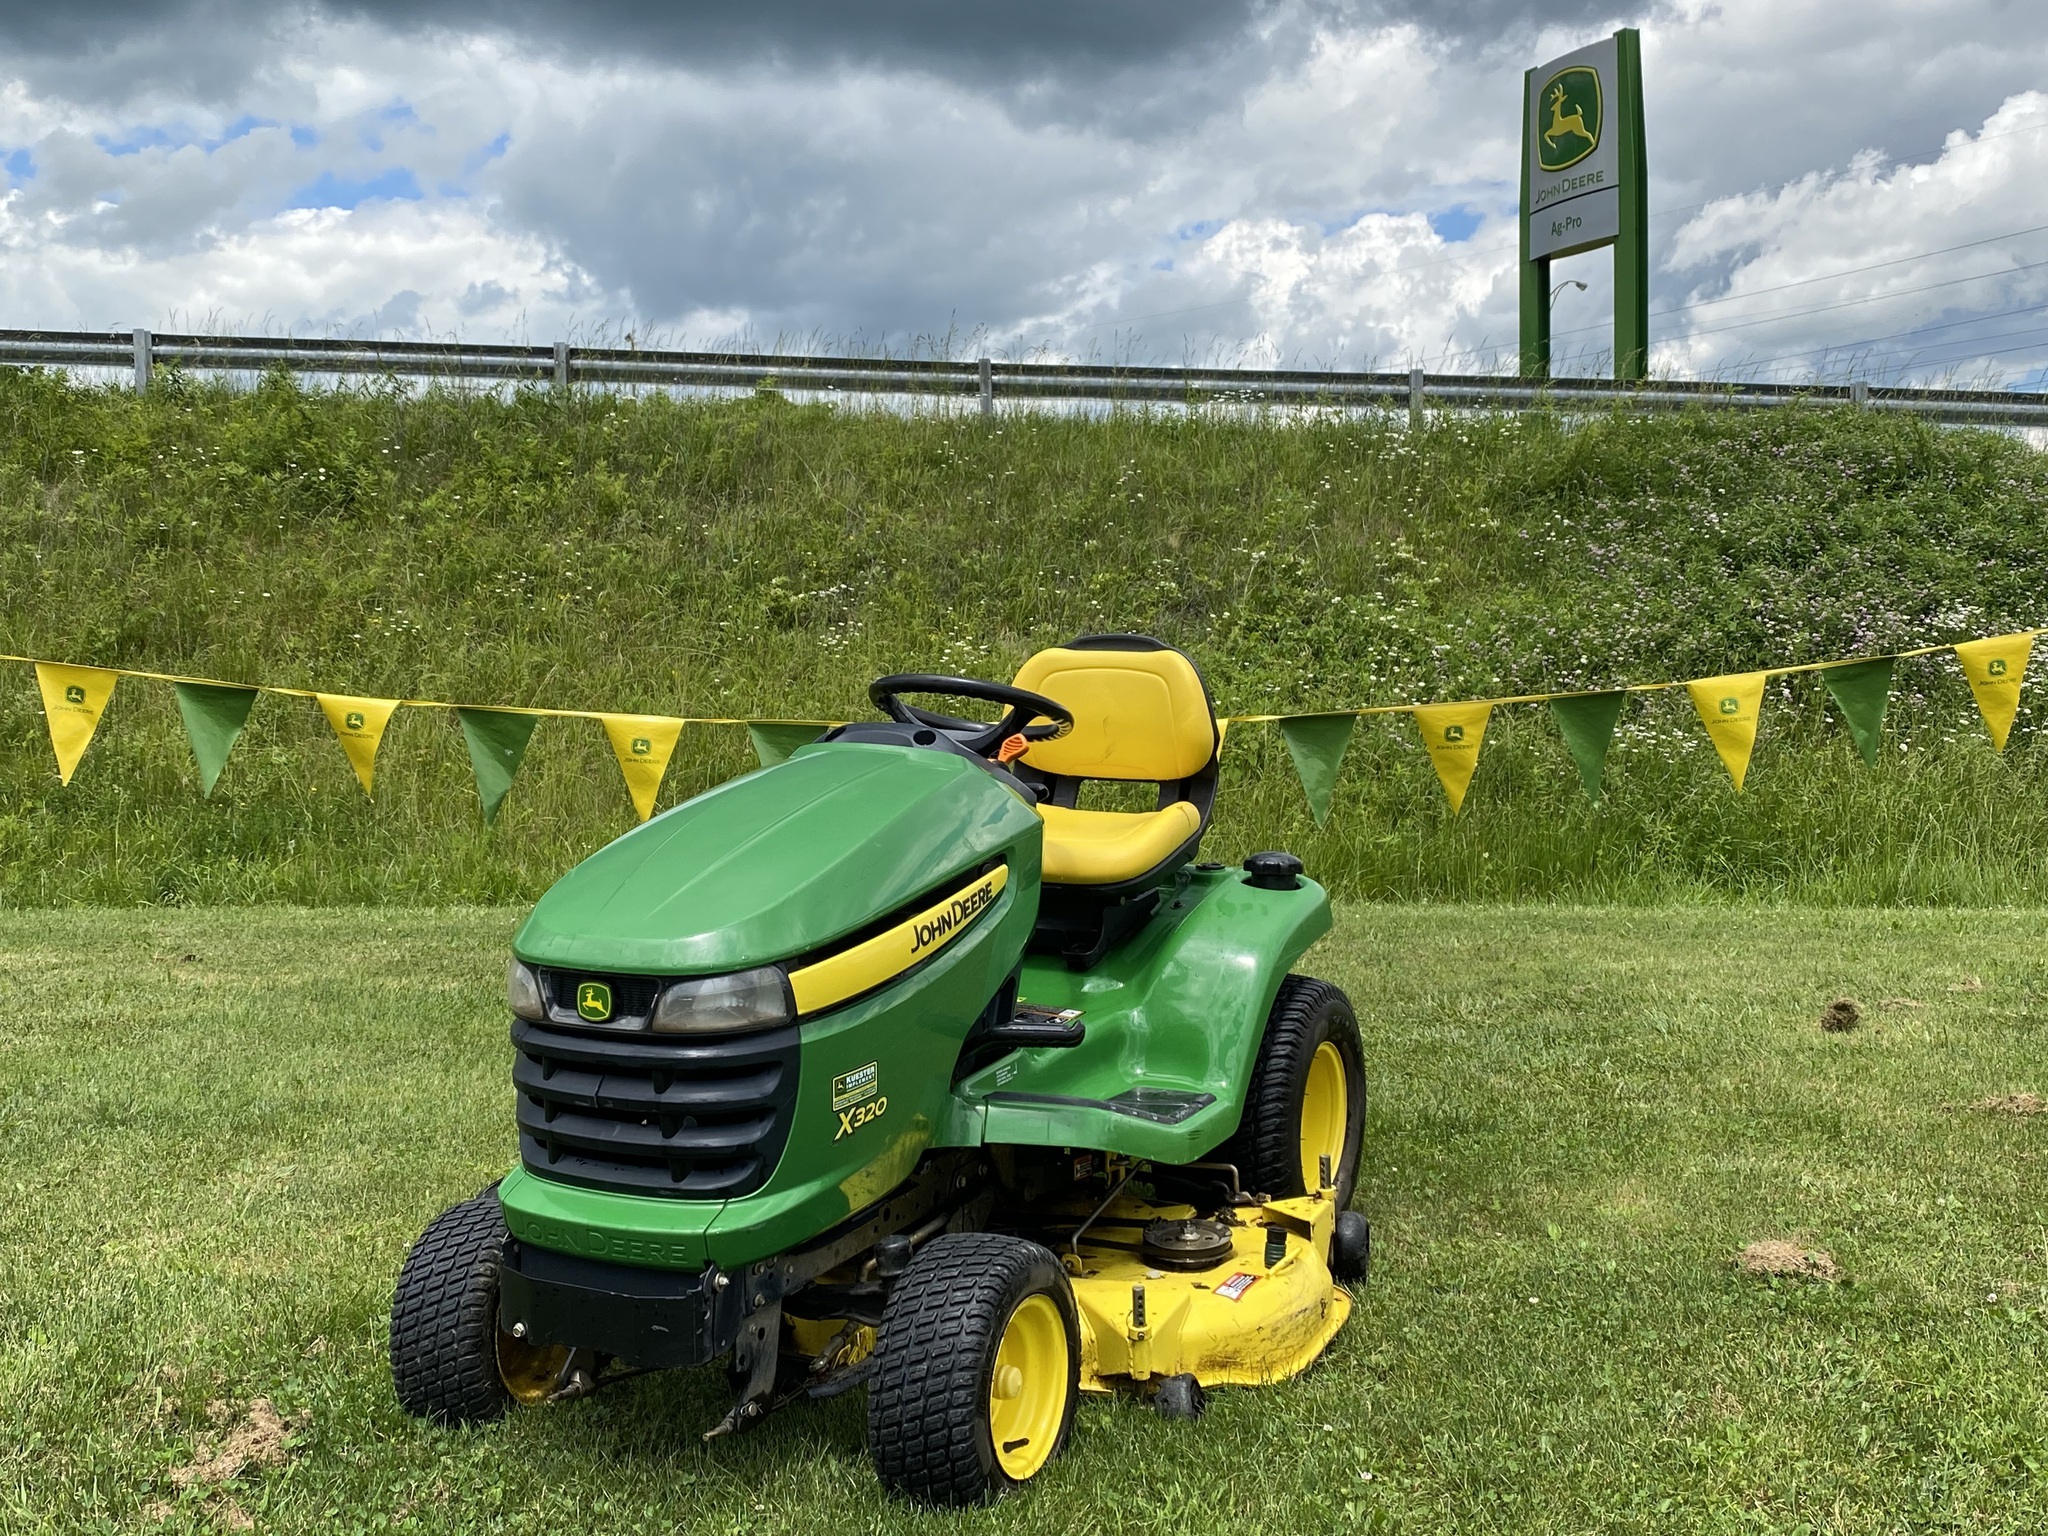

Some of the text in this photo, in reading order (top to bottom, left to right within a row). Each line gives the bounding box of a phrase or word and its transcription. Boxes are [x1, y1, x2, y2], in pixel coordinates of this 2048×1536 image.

[1535, 170, 1604, 204] JOHN DEERE
[1551, 216, 1582, 237] Ag-Pro
[910, 881, 993, 954] JOHN DEERE
[834, 1096, 888, 1141] X320
[516, 1214, 688, 1264] JOHN DEERE
